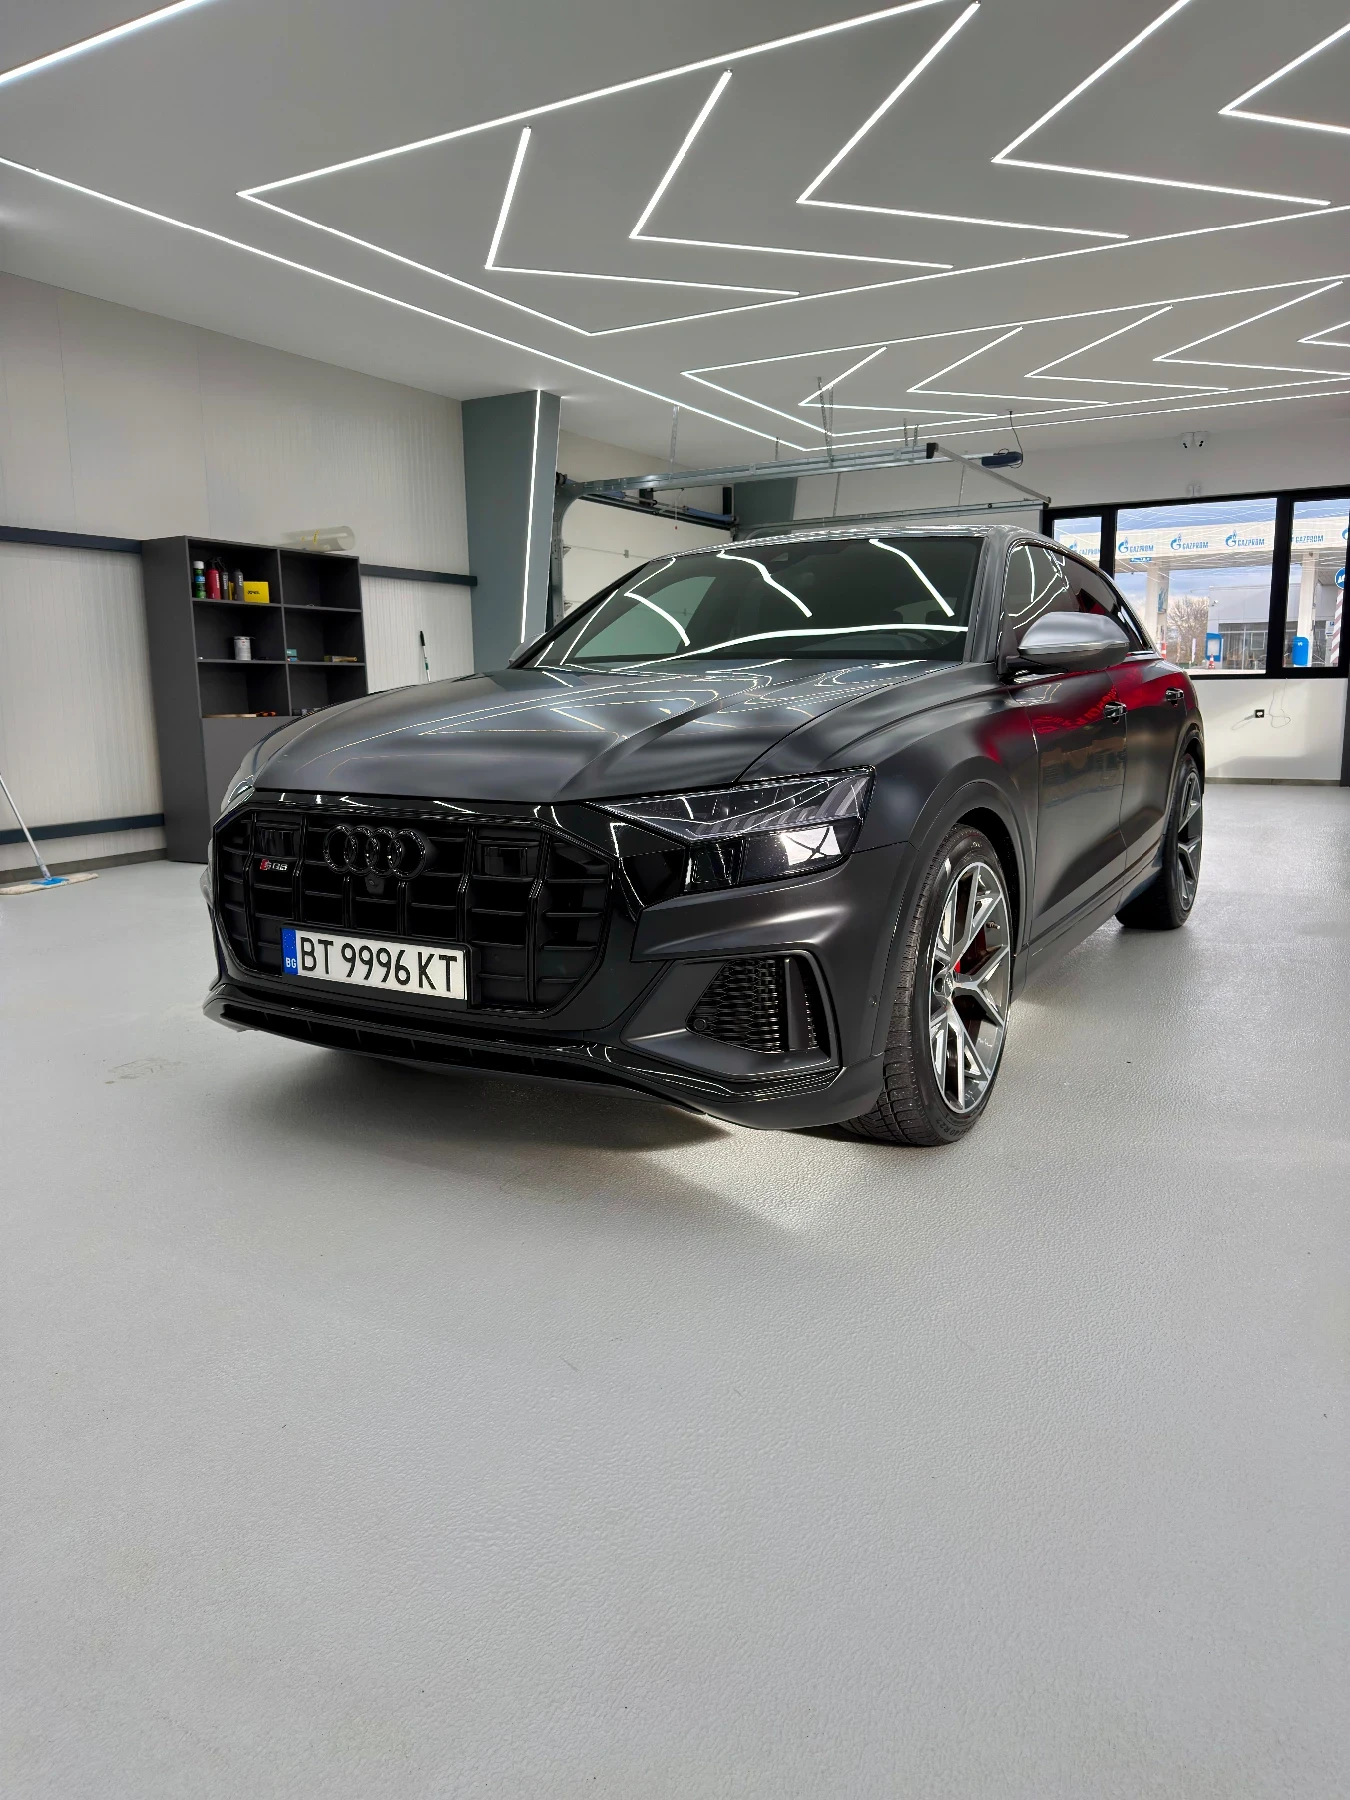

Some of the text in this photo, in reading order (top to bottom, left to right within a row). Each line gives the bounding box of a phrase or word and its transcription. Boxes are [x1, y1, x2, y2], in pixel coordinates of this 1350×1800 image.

[1237, 538, 1265, 547] GAZPROM
[1295, 535, 1324, 543] GAZPROM
[1129, 544, 1154, 553] GAZPROM
[1182, 541, 1209, 550] GAZPROM
[285, 957, 297, 969] BG
[300, 936, 458, 993] BT 9996 KT
